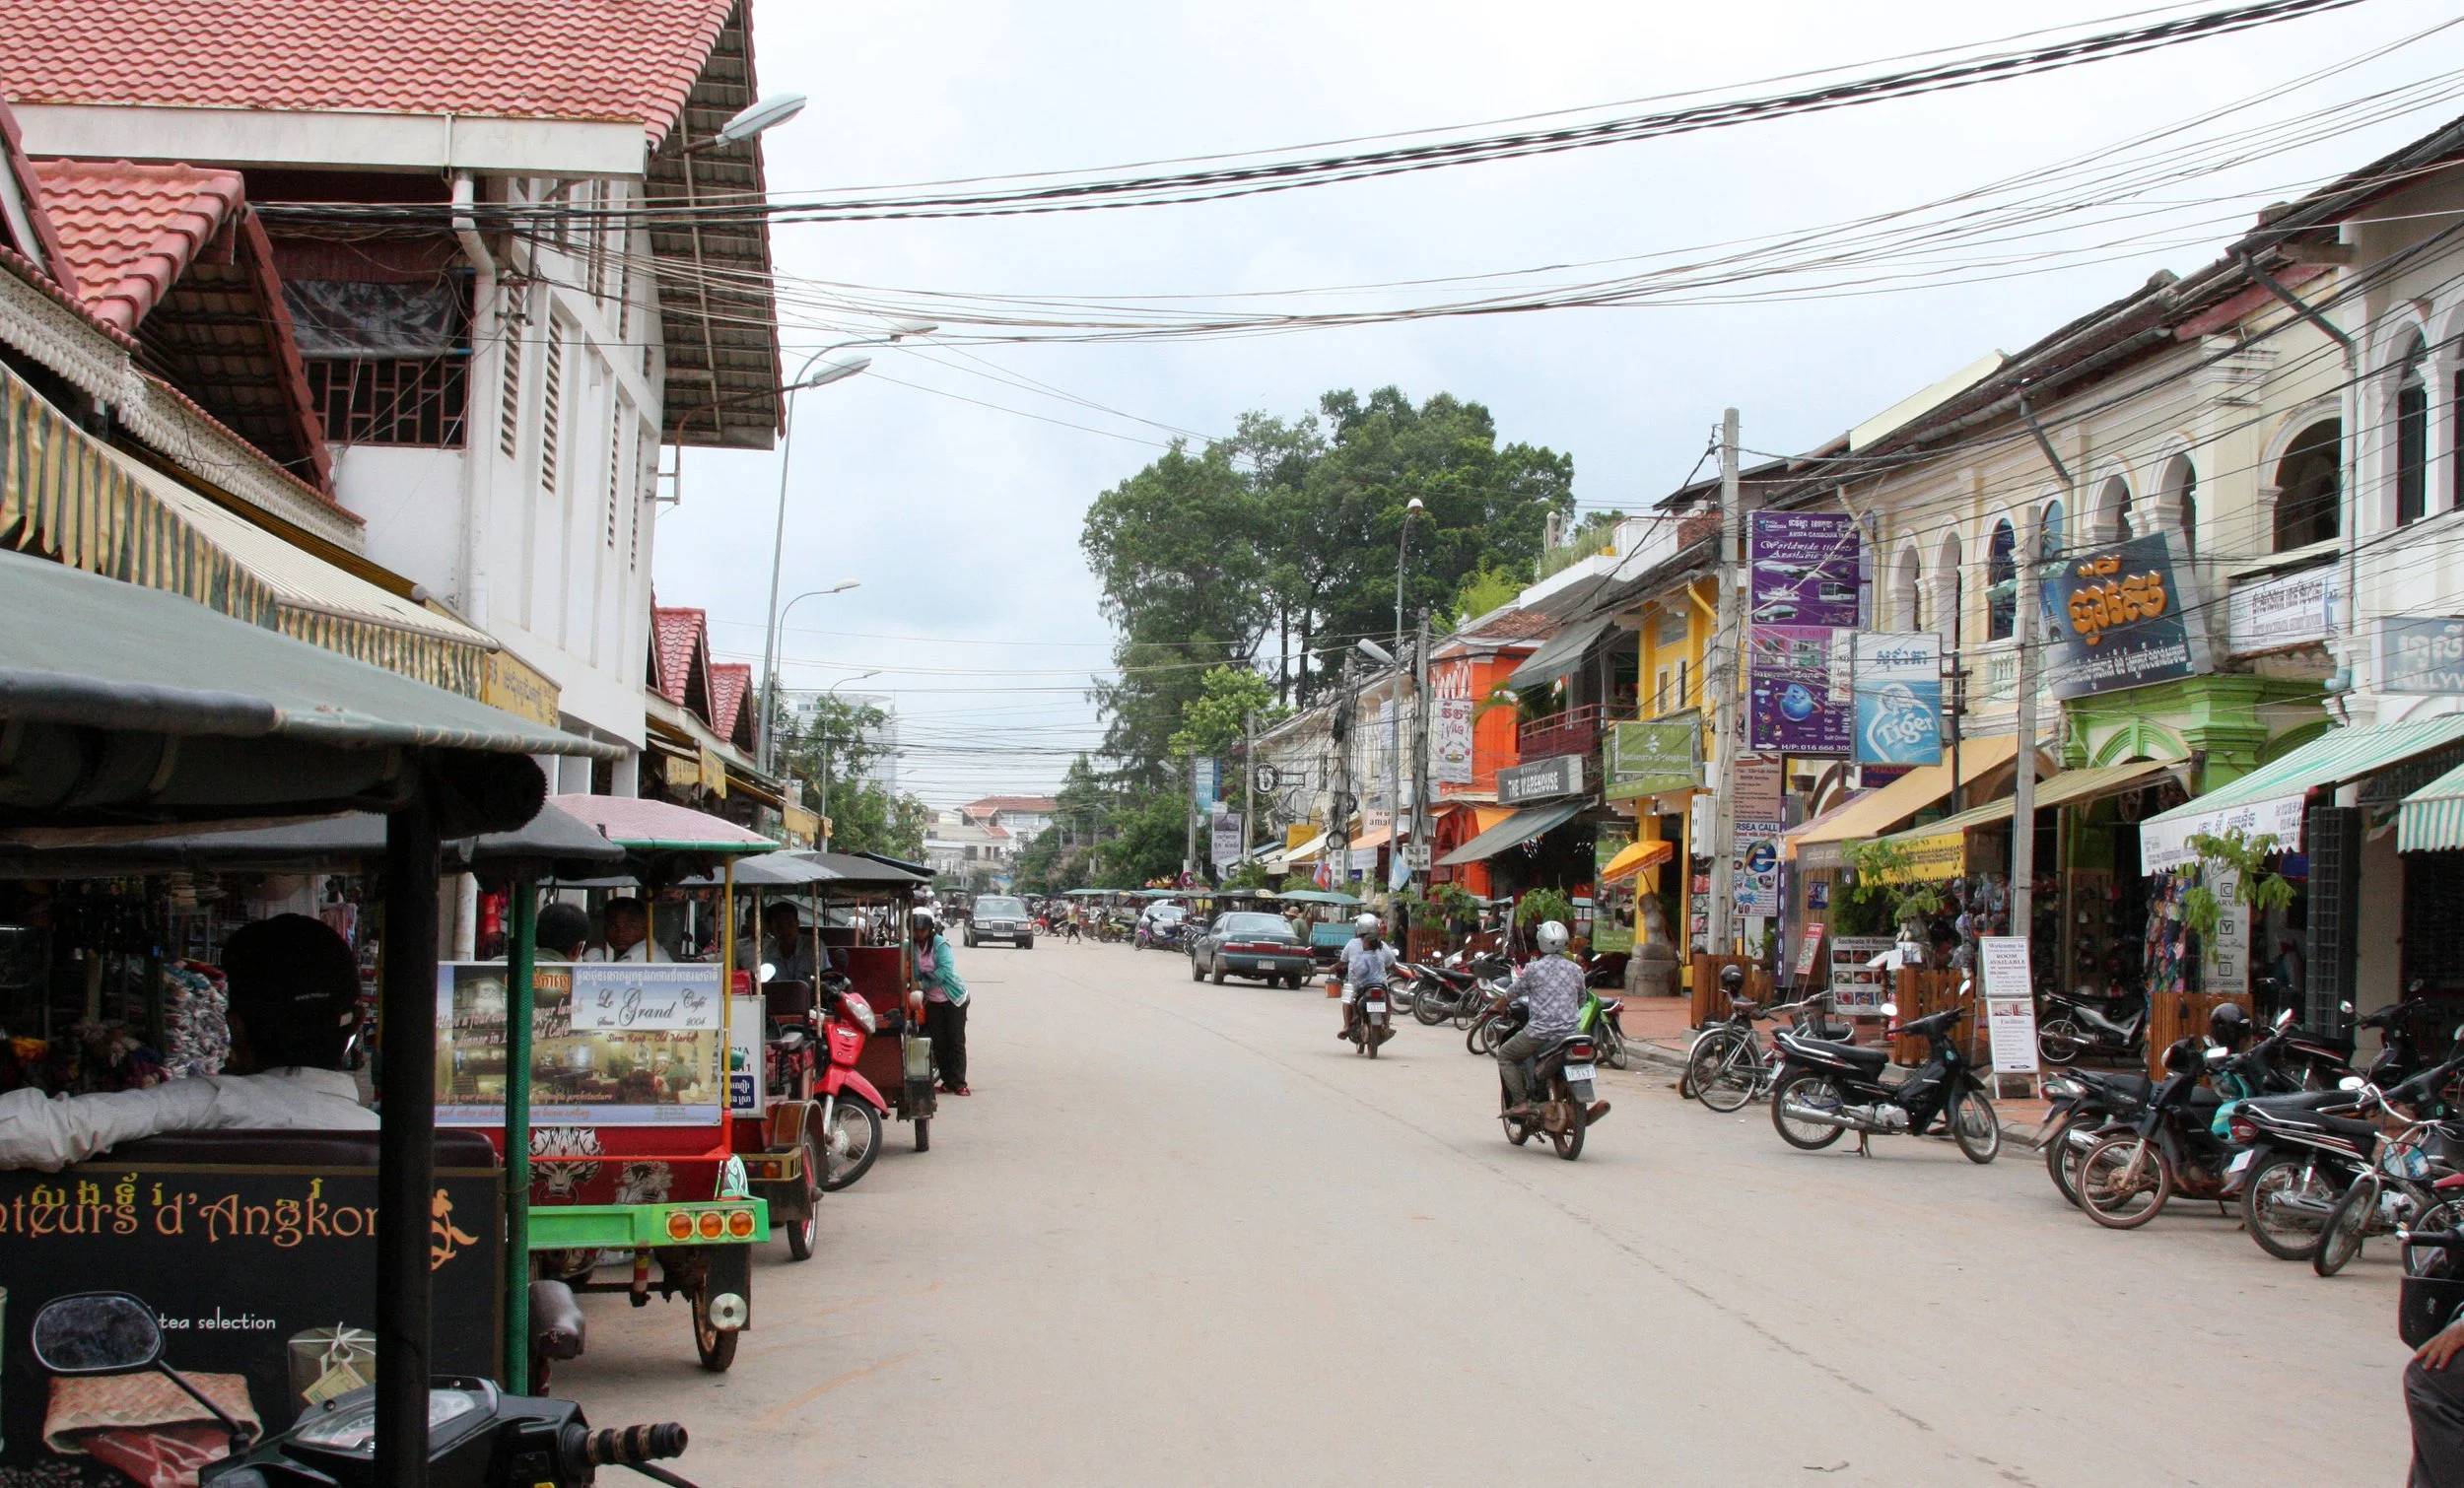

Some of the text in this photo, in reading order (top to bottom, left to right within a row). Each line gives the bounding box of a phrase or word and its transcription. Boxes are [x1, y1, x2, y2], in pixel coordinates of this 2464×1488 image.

[1760, 540, 1818, 551] Worldwide
[1876, 711, 1935, 747] Tiger
[1508, 772, 1559, 797] THE WAREHOUSE
[1735, 822, 1778, 832] RSEA CALL
[596, 987, 708, 1027] Le Grand Café
[159, 1306, 276, 1330] tea selection
